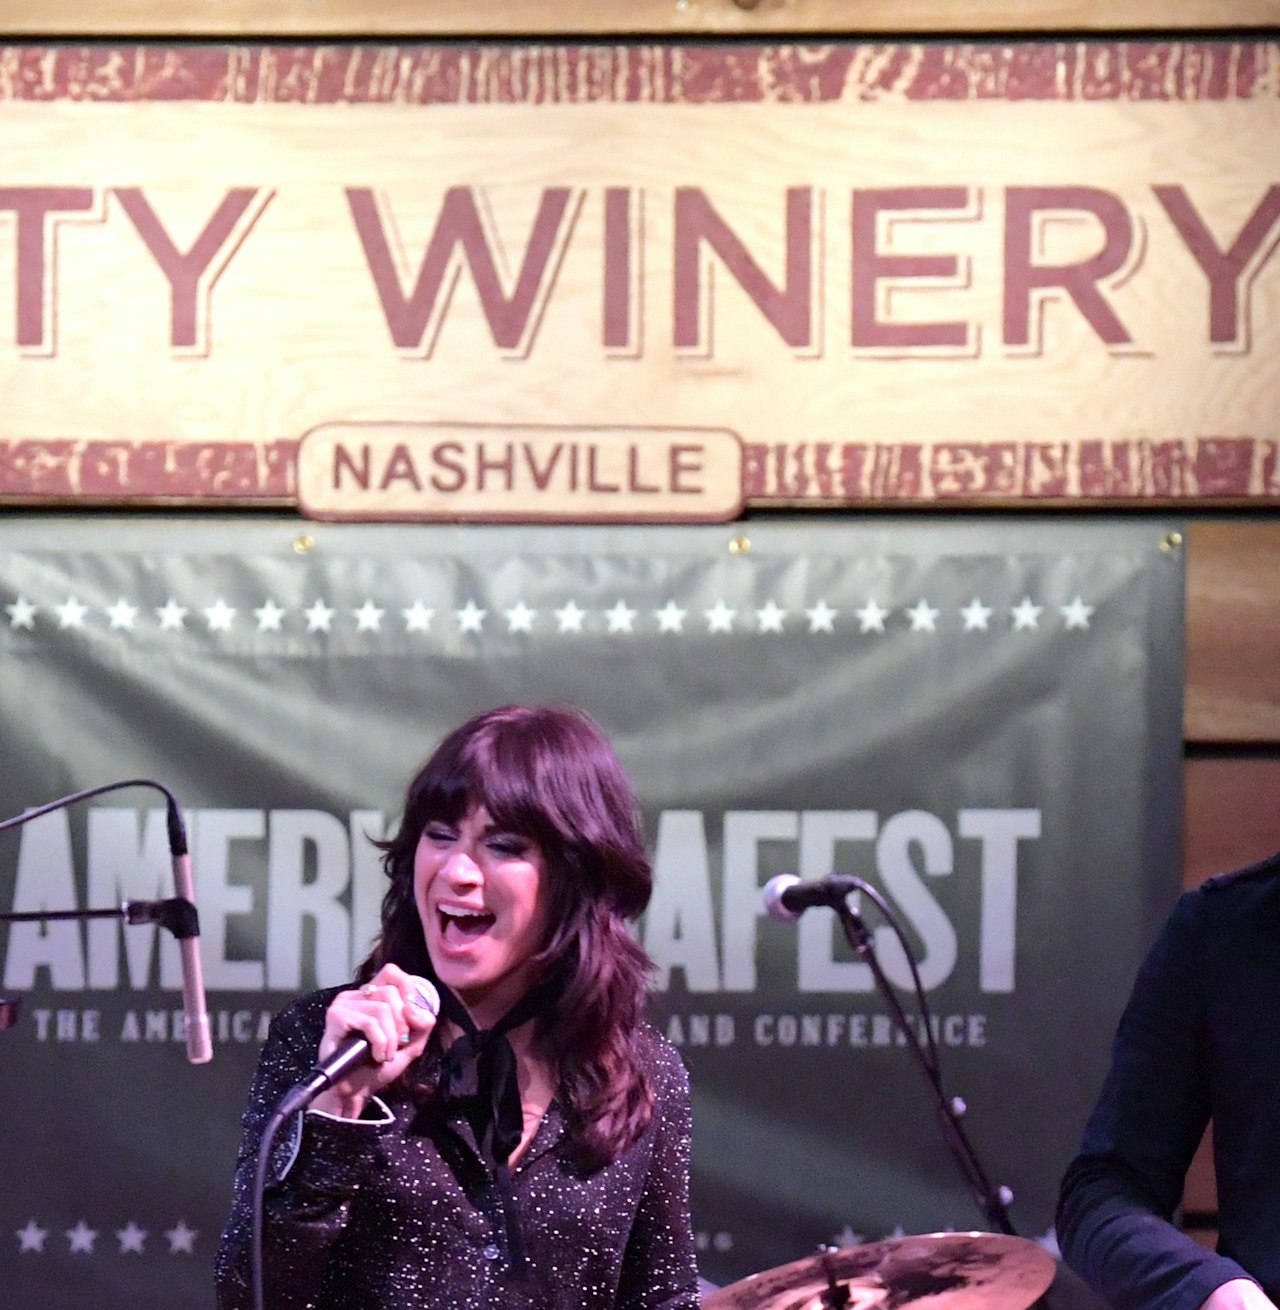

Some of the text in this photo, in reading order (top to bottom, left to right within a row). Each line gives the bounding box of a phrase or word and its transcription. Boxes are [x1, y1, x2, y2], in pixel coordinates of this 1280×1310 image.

[332, 442, 706, 494] NASHVILLE
[33, 1008, 101, 1042] THE
[667, 1013, 736, 1046] AND
